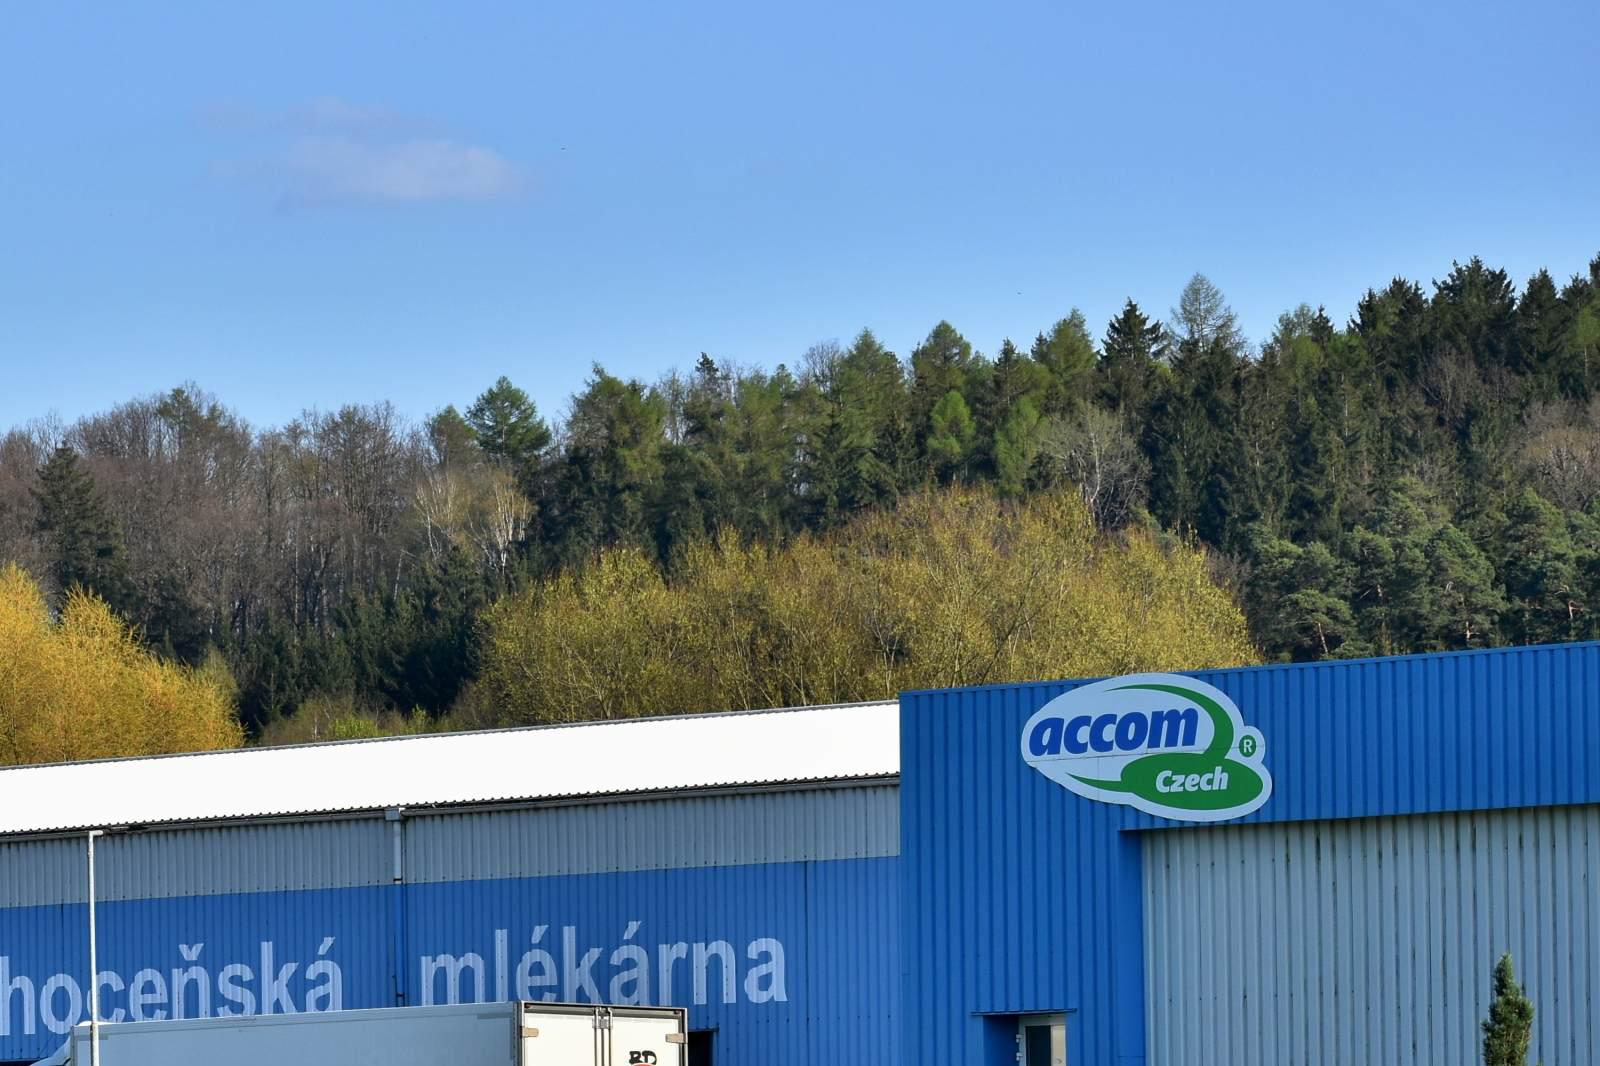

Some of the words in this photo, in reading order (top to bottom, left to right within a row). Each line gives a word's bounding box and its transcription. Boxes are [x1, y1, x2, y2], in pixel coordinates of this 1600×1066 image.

[1028, 707, 1199, 757] accom
[1155, 766, 1229, 793] Czech
[420, 920, 788, 1006] mlékárna
